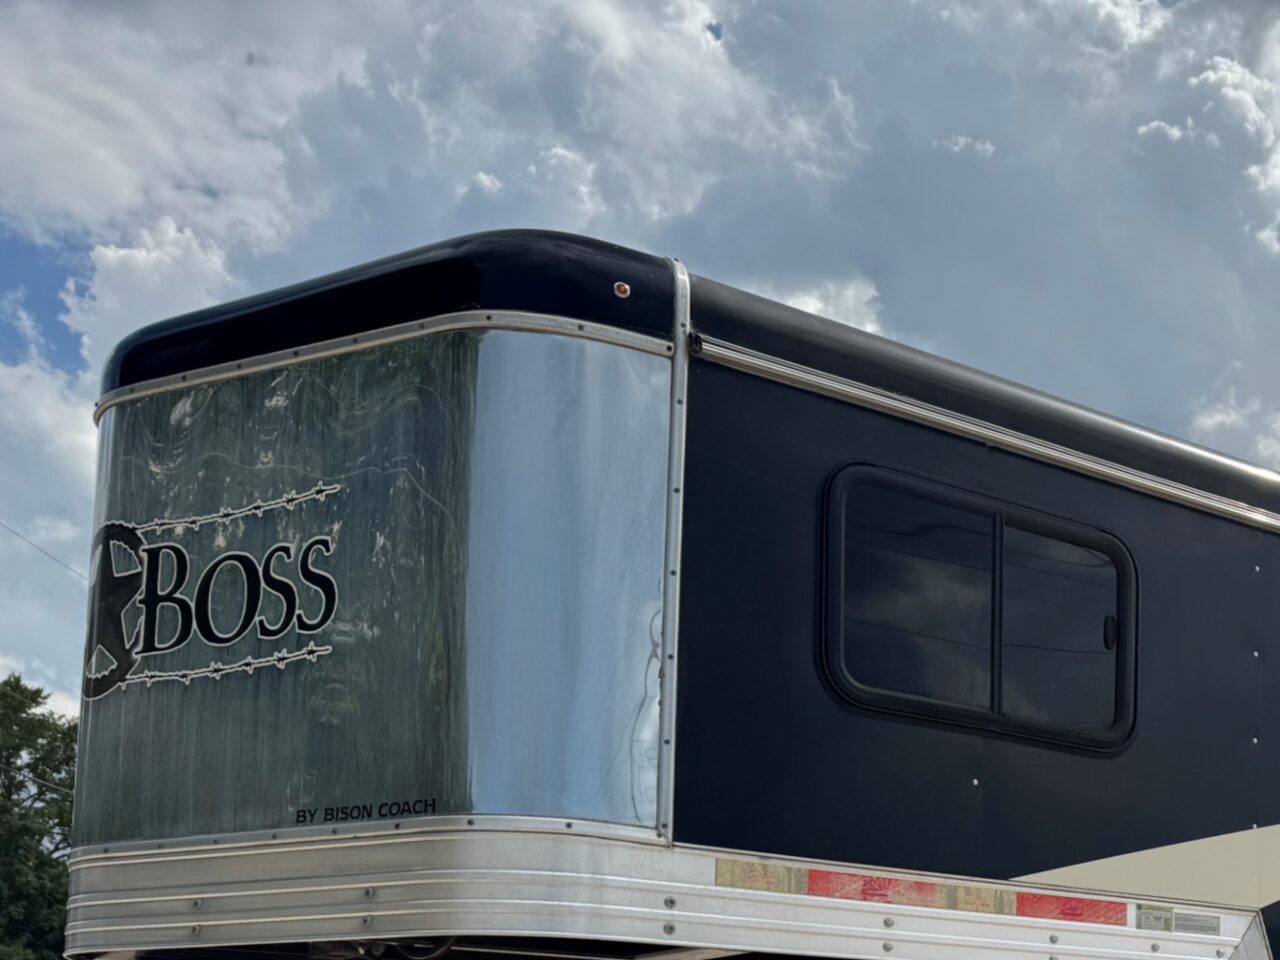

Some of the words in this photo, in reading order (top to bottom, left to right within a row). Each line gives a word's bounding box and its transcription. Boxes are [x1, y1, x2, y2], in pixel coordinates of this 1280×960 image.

[133, 534, 338, 657] BOSS
[296, 808, 318, 823] BY
[324, 804, 373, 821] BISON
[378, 798, 437, 817] COACH
